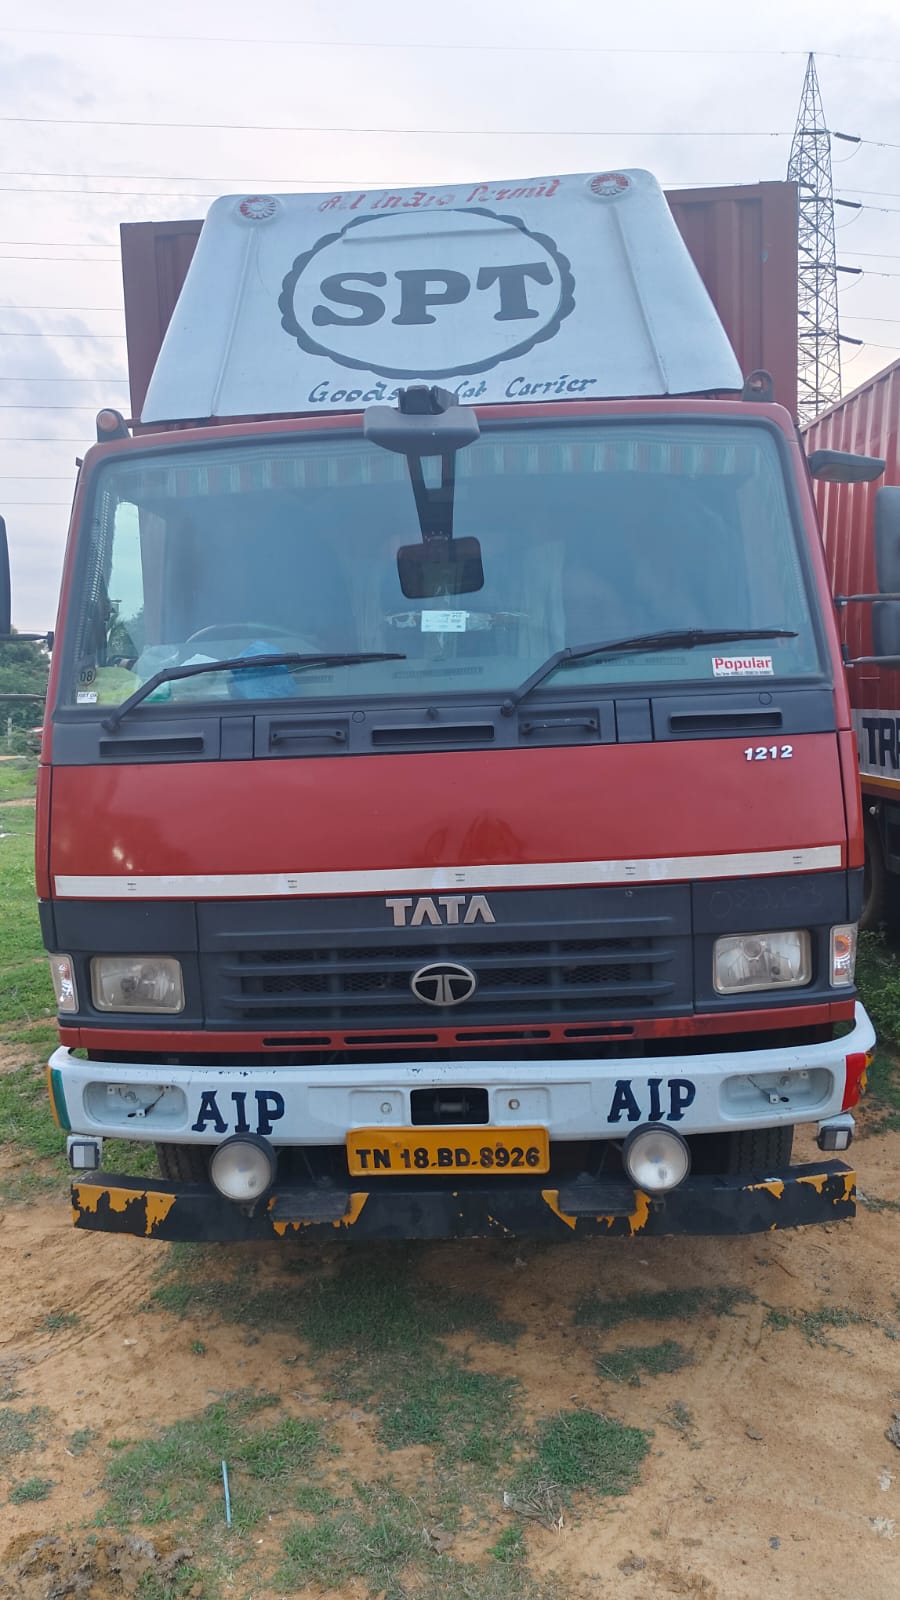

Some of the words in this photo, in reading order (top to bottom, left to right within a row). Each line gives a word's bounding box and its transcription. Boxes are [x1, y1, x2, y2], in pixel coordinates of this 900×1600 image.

[312, 261, 553, 326] SPT
[505, 374, 597, 398] Carrier
[714, 656, 772, 671] Popular
[744, 744, 793, 761] 1212
[385, 895, 496, 927] TATA
[191, 1089, 285, 1135] AIP
[607, 1078, 696, 1123] AIP
[355, 1148, 391, 1169] TN
